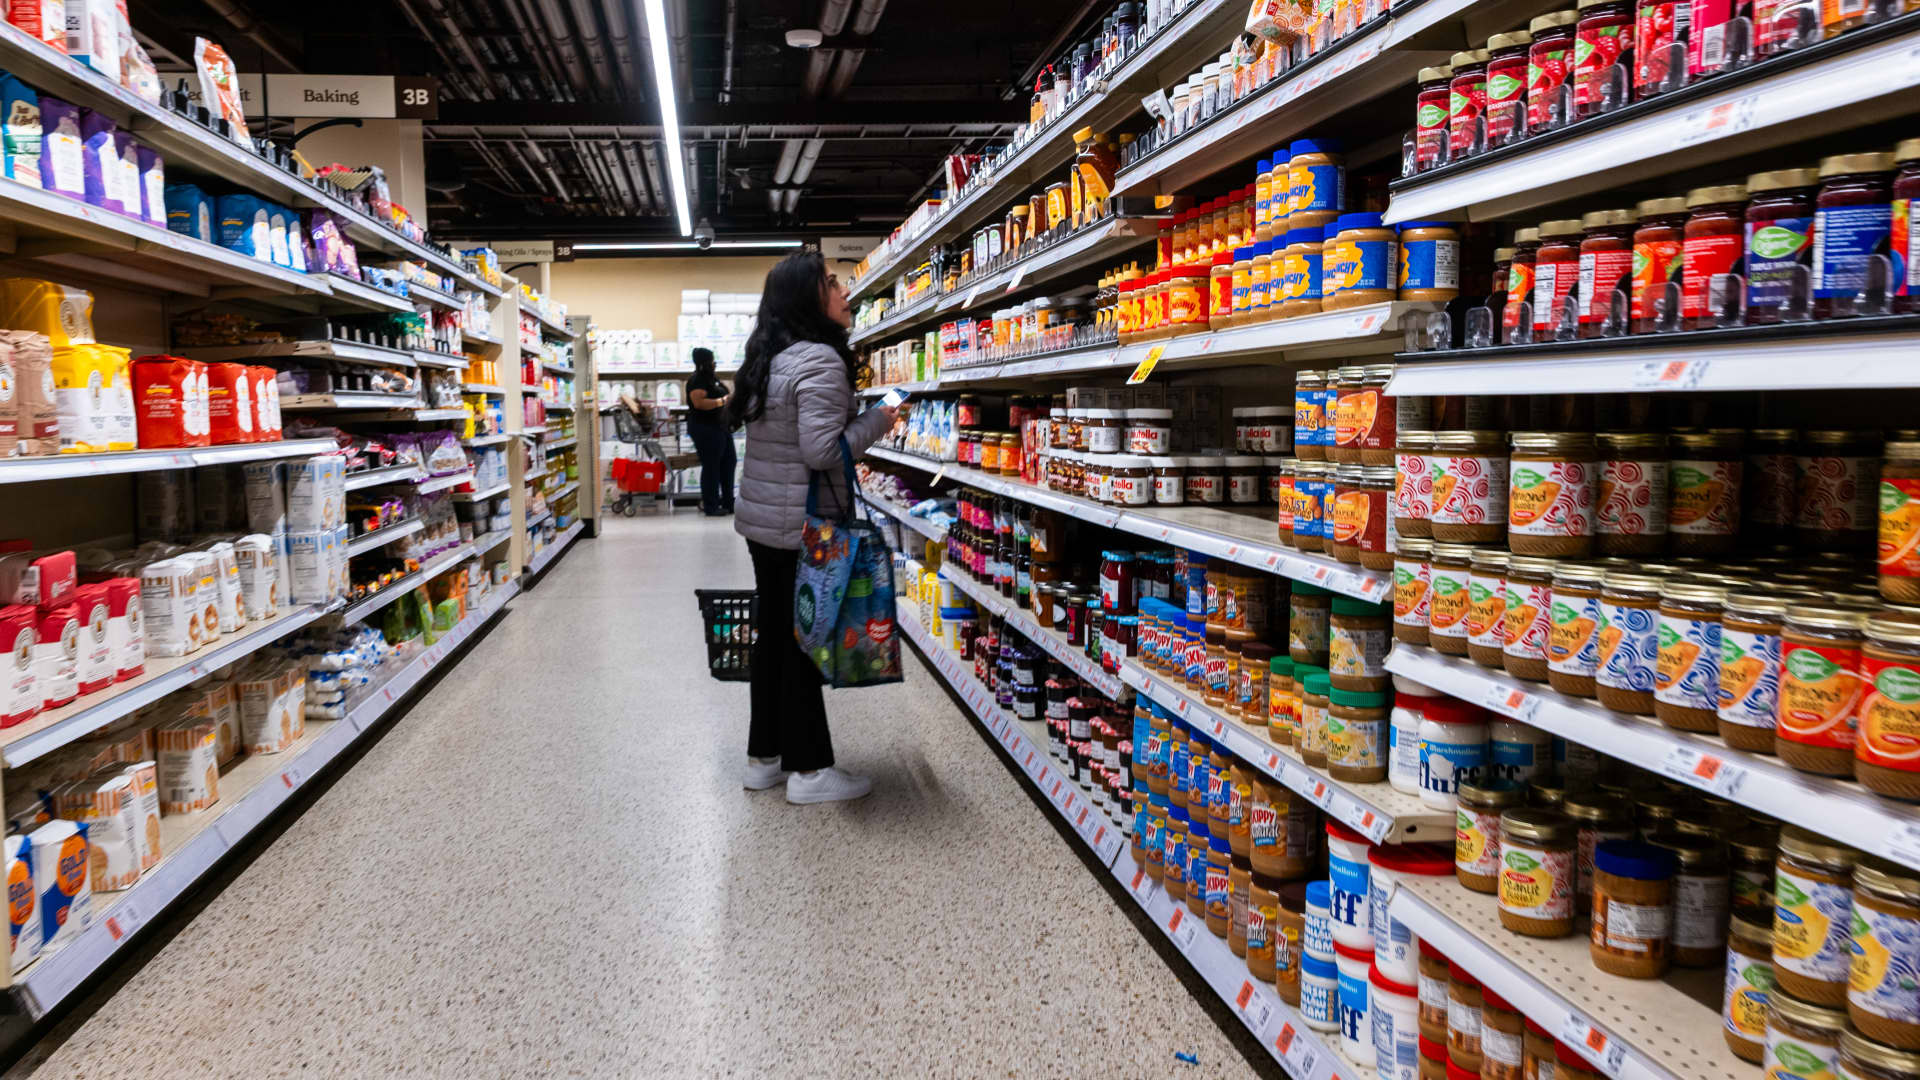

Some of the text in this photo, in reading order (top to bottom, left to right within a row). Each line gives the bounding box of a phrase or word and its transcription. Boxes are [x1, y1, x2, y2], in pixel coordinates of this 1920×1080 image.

[303, 88, 360, 106] Baking
[402, 88, 430, 105] 3B
[557, 246, 571, 256] 3B
[1113, 480, 1133, 490] tella
[1186, 649, 1200, 666] SKI
[1206, 661, 1225, 674] SKIPP
[1252, 808, 1275, 825] KIPPY
[1207, 876, 1228, 892] KIPP
